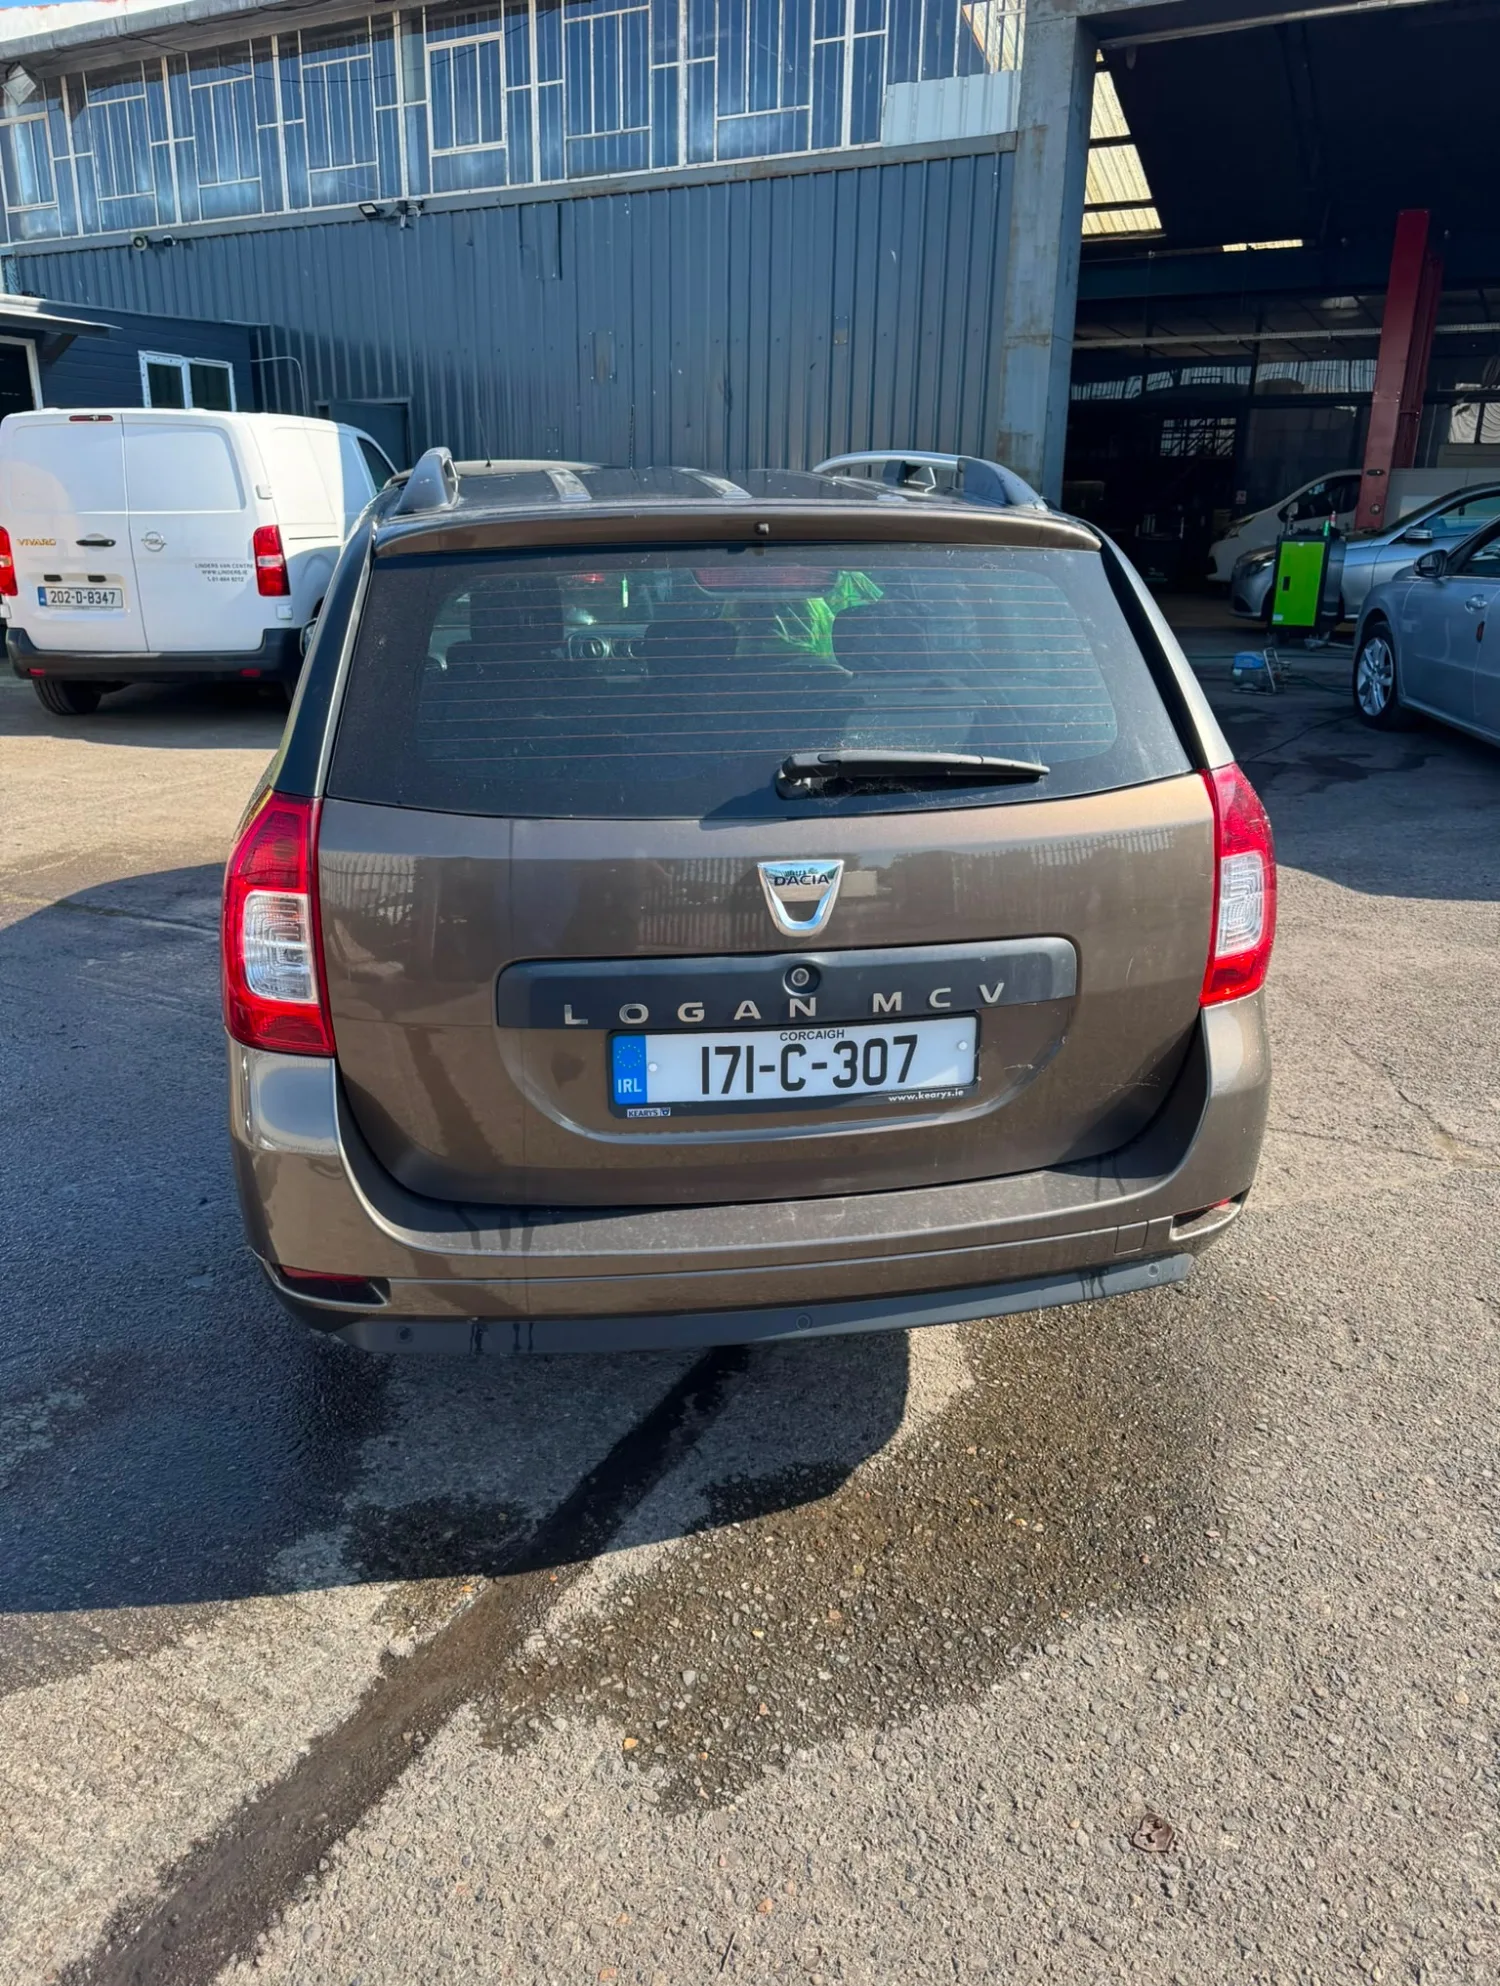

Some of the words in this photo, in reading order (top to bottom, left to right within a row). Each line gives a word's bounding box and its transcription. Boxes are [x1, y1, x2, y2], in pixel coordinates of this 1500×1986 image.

[16, 538, 57, 546] VIVARO
[50, 590, 116, 605] 202-D-8347
[774, 874, 830, 886] DACIA
[563, 997, 817, 1025] LOGAN
[779, 1029, 845, 1042] CORCAIGH
[701, 1034, 918, 1095] 171-C-307
[617, 1077, 643, 1094] IRL
[888, 1089, 964, 1102] www.kearys.ie
[628, 1109, 659, 1117] KEARYS
